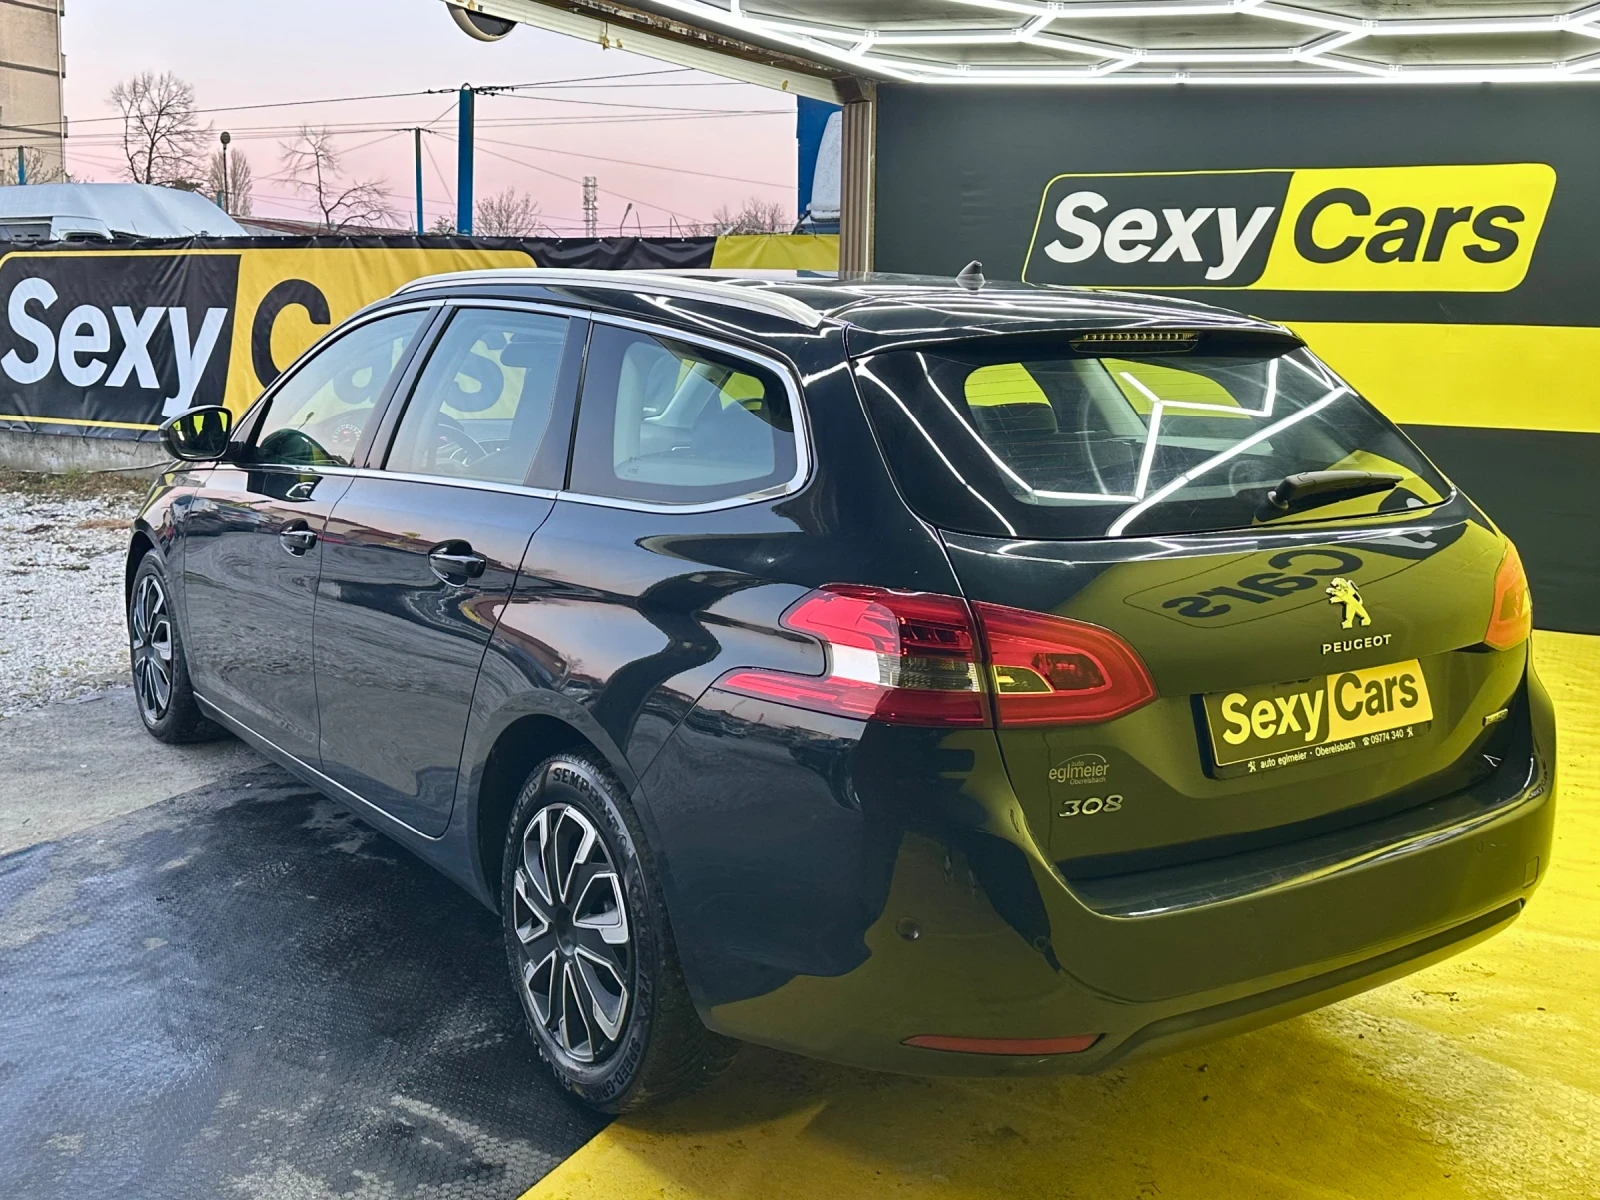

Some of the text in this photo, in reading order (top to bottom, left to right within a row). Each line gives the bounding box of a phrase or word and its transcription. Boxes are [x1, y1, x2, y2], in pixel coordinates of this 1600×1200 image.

[1044, 187, 1525, 281] Sexy Cars
[0, 277, 228, 418] Sexy
[1321, 633, 1392, 655] PEUGEOT
[1221, 672, 1419, 745] Sexy Cars
[1048, 762, 1110, 783] eglmeier
[1260, 728, 1404, 769] auto eglmeier Oberelsbach 09774 340
[553, 767, 621, 836] SEMPERIT
[1059, 794, 1124, 817] 308
